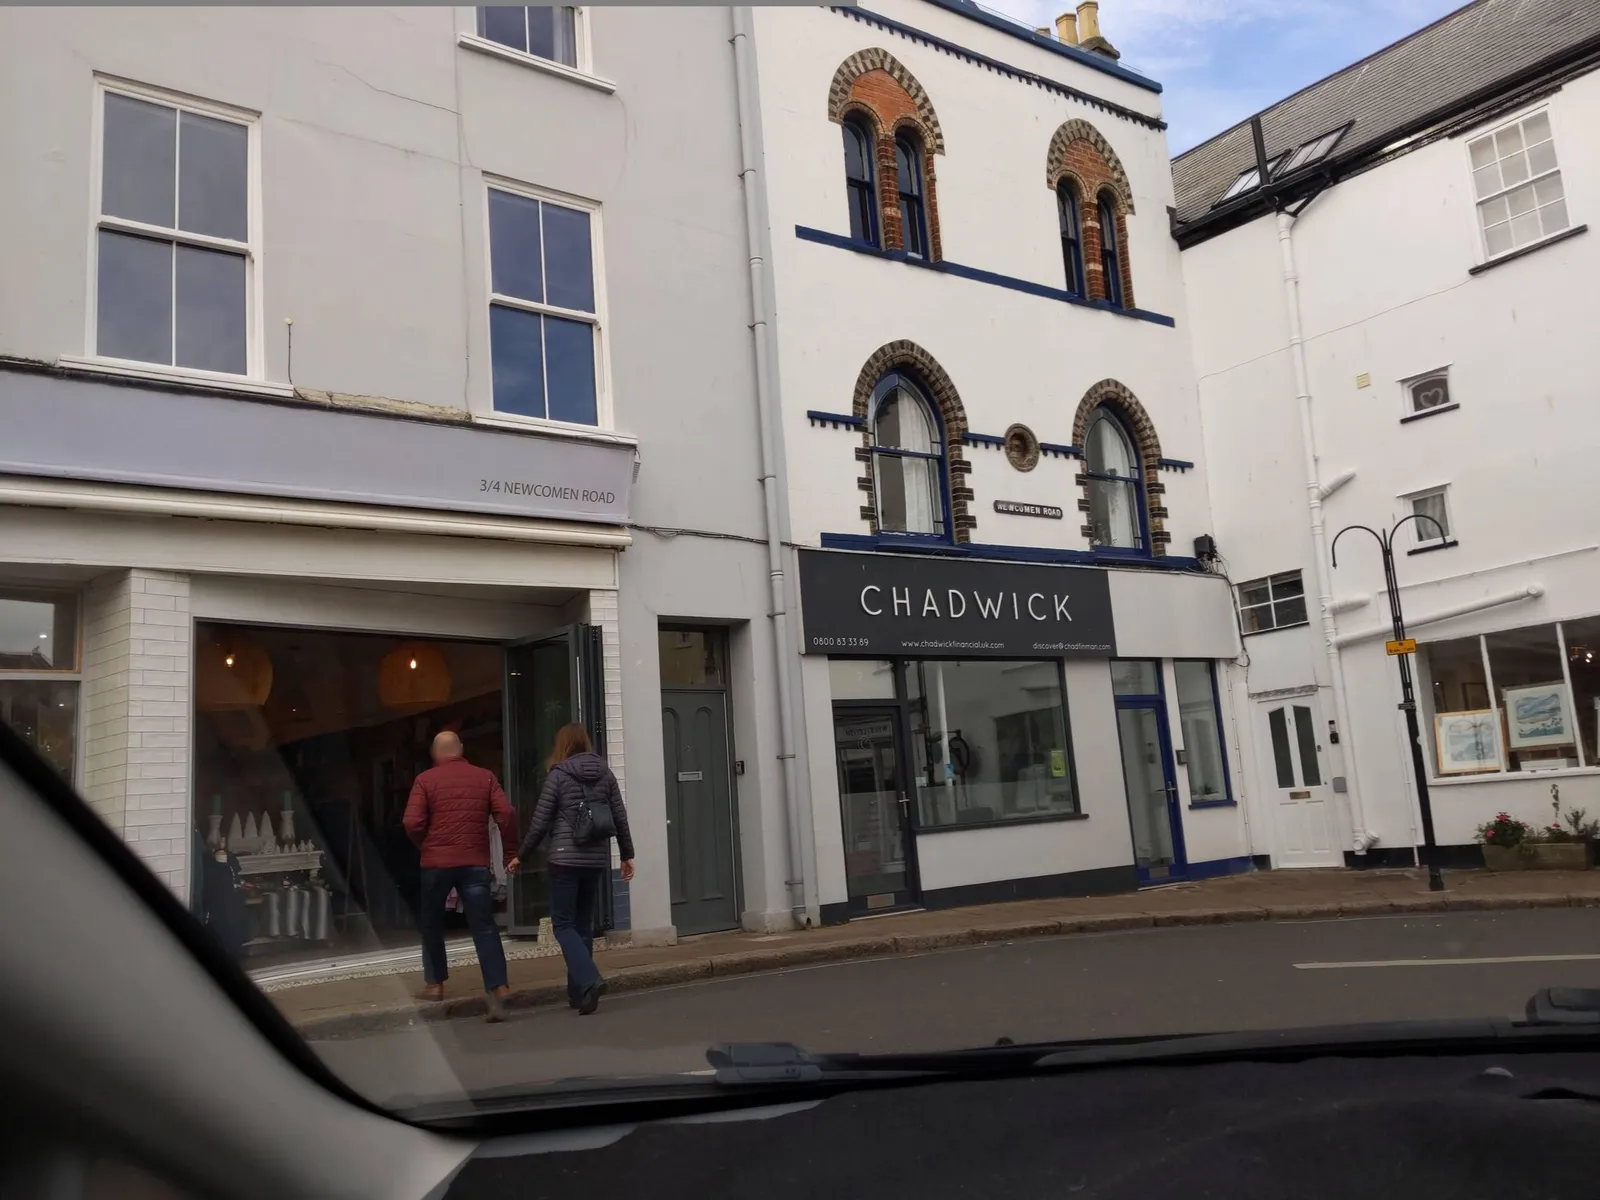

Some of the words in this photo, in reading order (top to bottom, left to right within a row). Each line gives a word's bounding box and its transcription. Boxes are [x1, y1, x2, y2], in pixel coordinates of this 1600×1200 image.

[480, 479, 501, 493] 3/4
[503, 481, 579, 501] NEWCOMEN
[581, 489, 616, 504] ROAD
[997, 503, 1041, 514] NEWCOMEN
[1043, 507, 1062, 517] ROAD
[860, 585, 1073, 622] CHADWICK
[813, 637, 835, 646] 0800
[836, 637, 847, 646] 83
[848, 637, 858, 646] 33
[858, 637, 869, 647] 89
